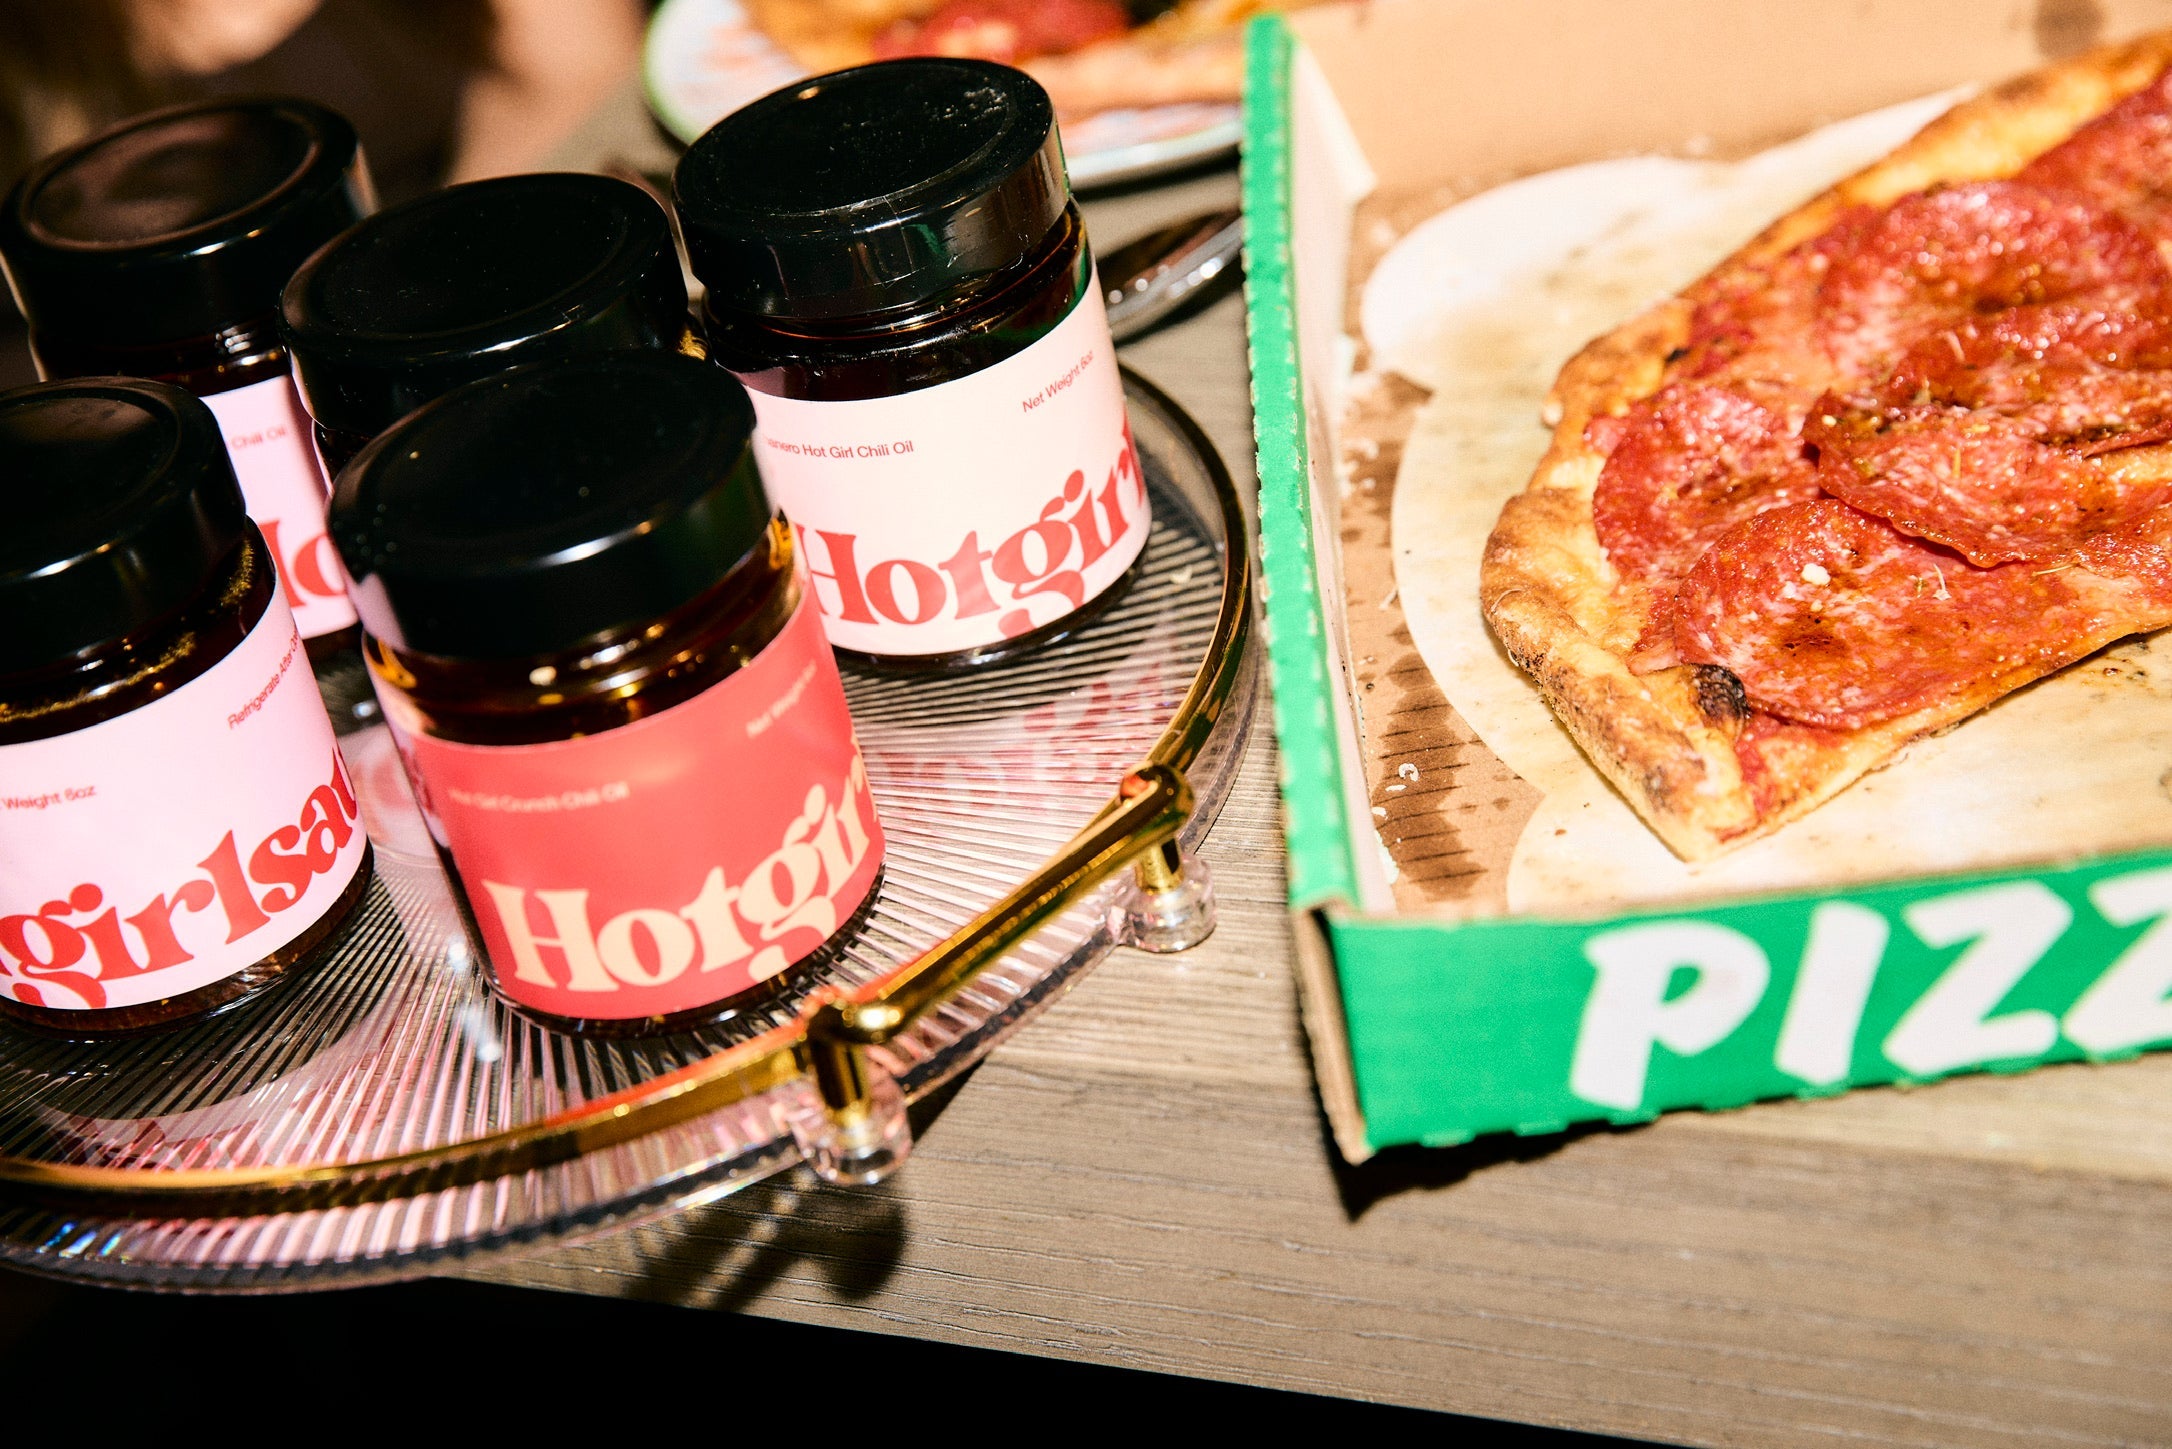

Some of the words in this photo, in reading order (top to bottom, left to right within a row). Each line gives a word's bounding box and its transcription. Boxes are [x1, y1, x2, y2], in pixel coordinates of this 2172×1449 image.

[1022, 391, 1044, 413] Net
[1045, 364, 1080, 398] Weight
[802, 443, 827, 458] Hot
[830, 446, 855, 459] Girl
[857, 443, 890, 458] Chili
[893, 440, 914, 455] Oil
[227, 673, 281, 730] Refrigerate
